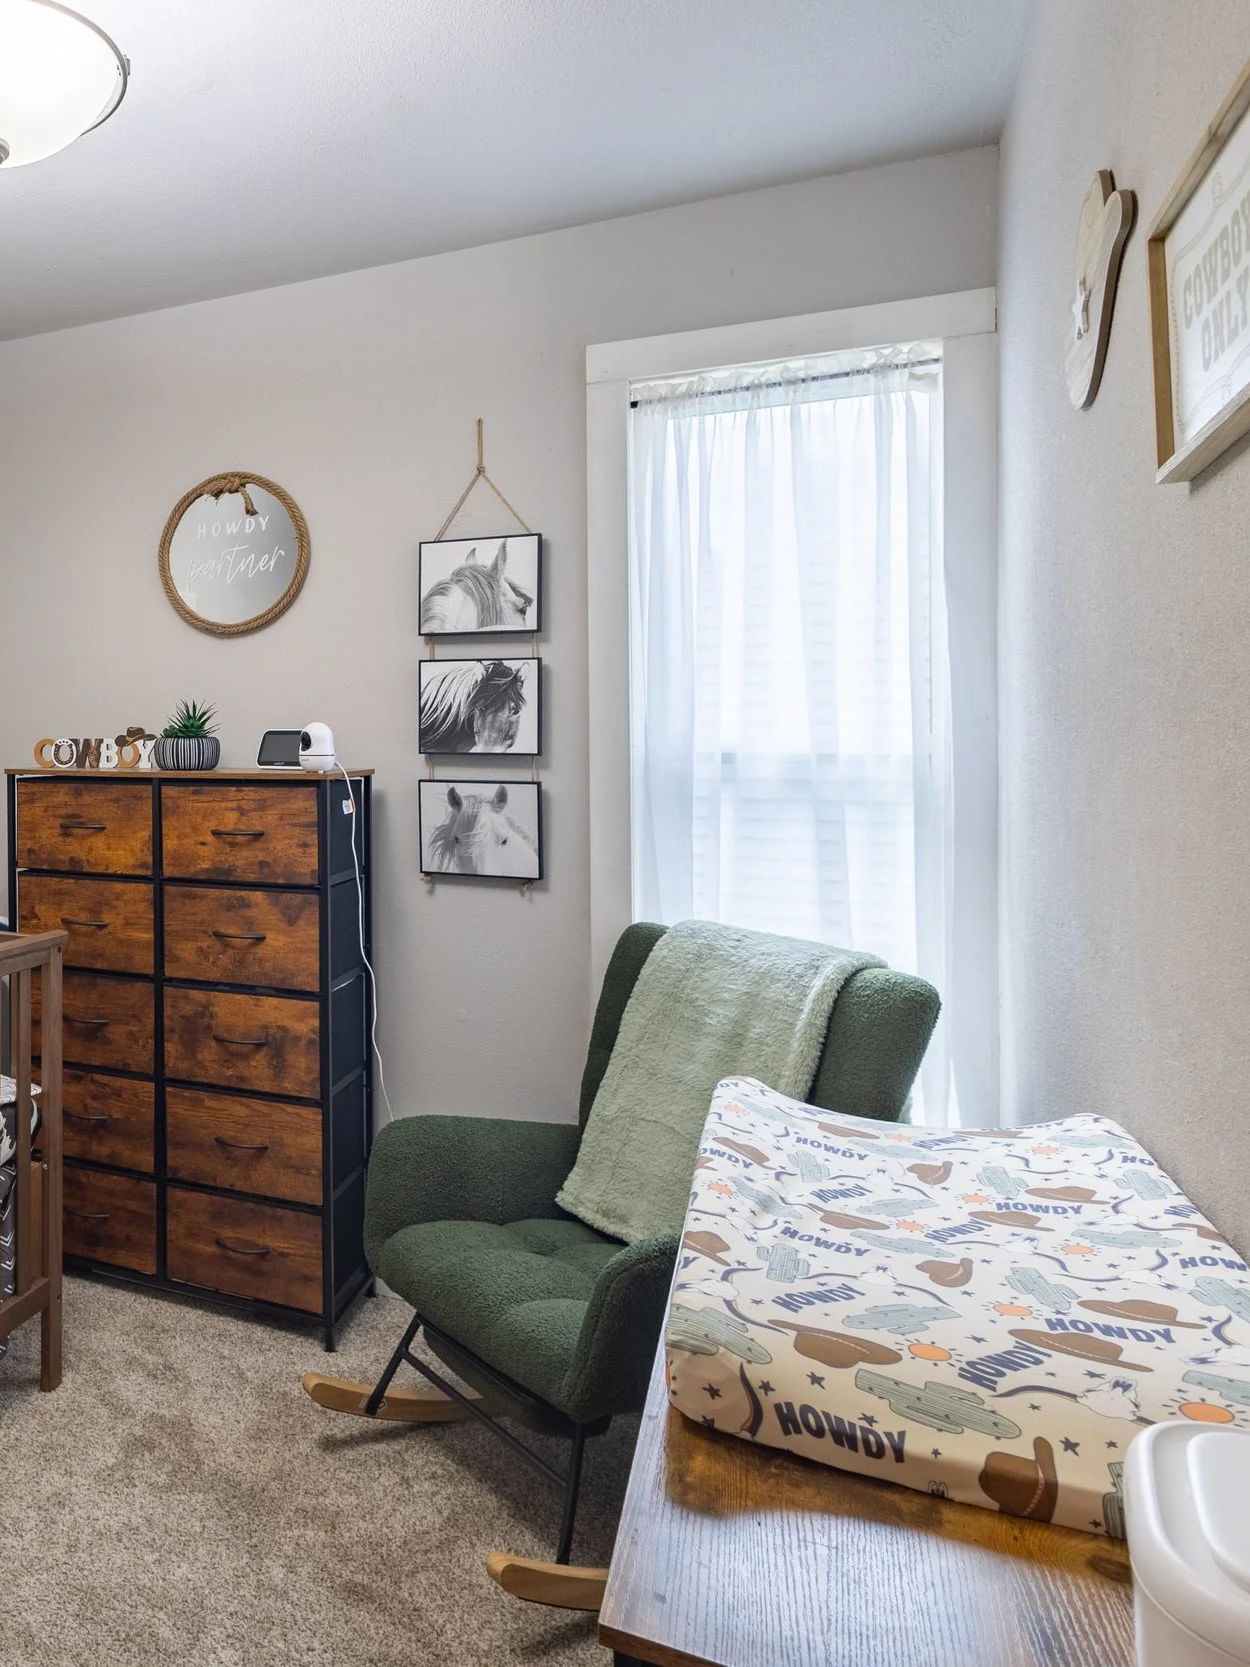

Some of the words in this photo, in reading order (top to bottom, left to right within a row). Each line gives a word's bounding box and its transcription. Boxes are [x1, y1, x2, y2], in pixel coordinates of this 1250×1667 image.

[1202, 265, 1249, 373] ONLY
[197, 515, 270, 539] HOWDY
[186, 542, 285, 593] partner
[33, 738, 156, 769] COWBOY
[698, 1148, 754, 1169] OWDY
[796, 1136, 870, 1161] HOWDY
[810, 1183, 873, 1204] HOWDY
[995, 1202, 1084, 1215] HOWDY
[780, 1225, 871, 1257] HOWDY
[924, 1218, 993, 1243] HOWDY
[1179, 1255, 1248, 1272] HOW
[771, 1283, 867, 1314] HOWDY
[1044, 1317, 1176, 1345] HOWDY
[957, 1339, 1053, 1392] HOWDY
[774, 1401, 907, 1464] HOWDY
